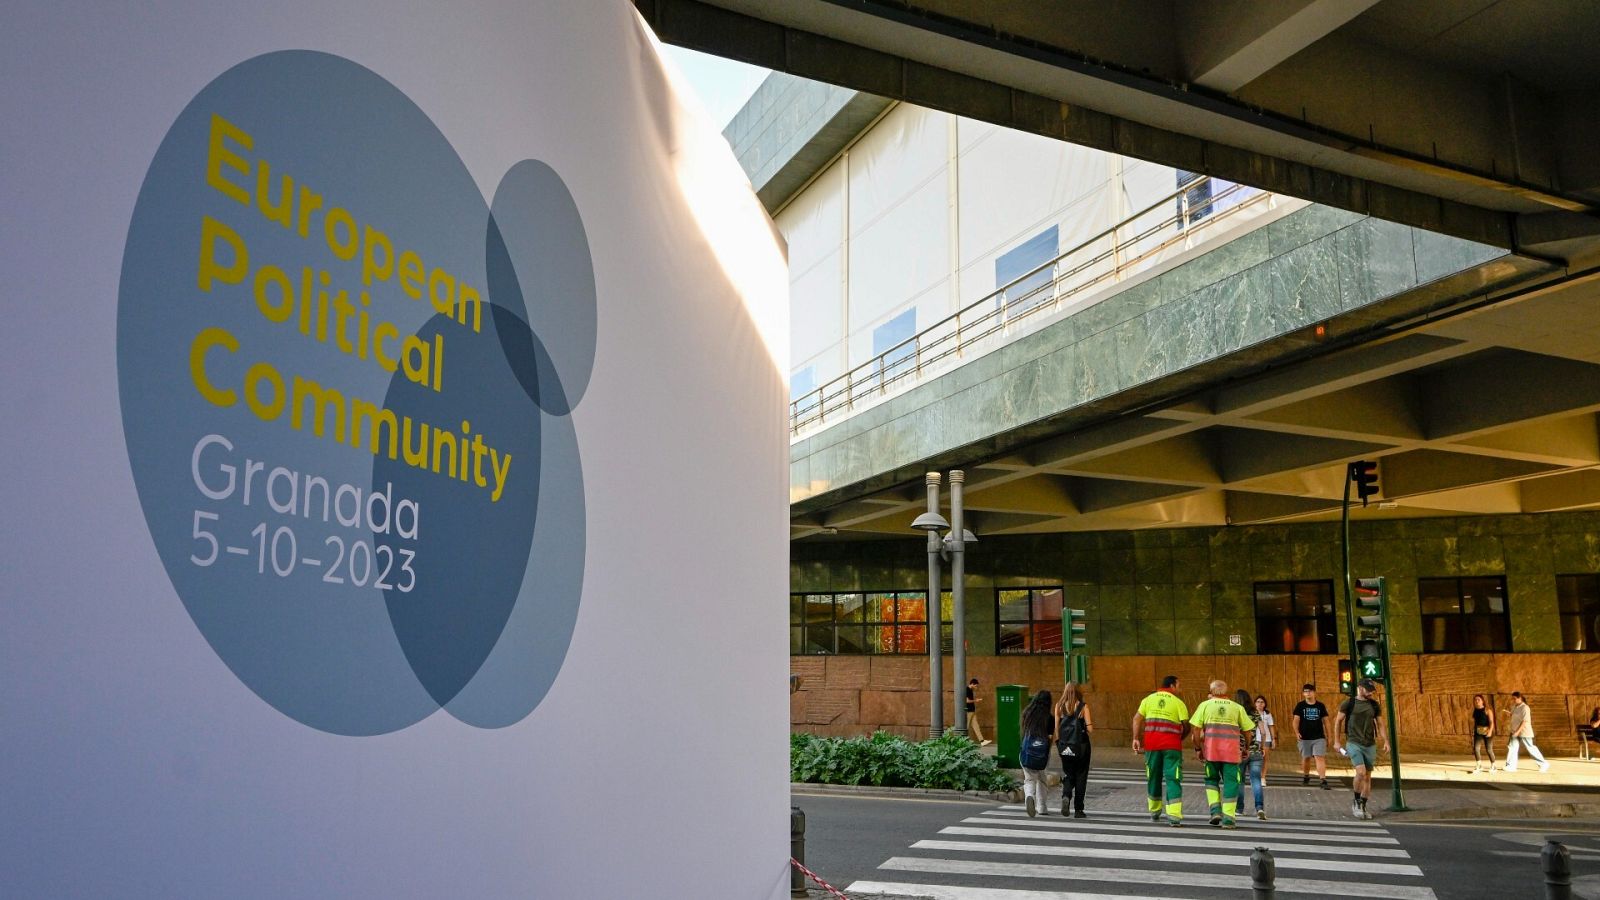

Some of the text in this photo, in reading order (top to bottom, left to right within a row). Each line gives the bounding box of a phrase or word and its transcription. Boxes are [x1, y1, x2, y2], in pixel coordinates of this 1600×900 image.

[198, 215, 444, 392] Political
[206, 114, 482, 333] European
[189, 327, 513, 502] Community
[191, 434, 420, 540] Granada
